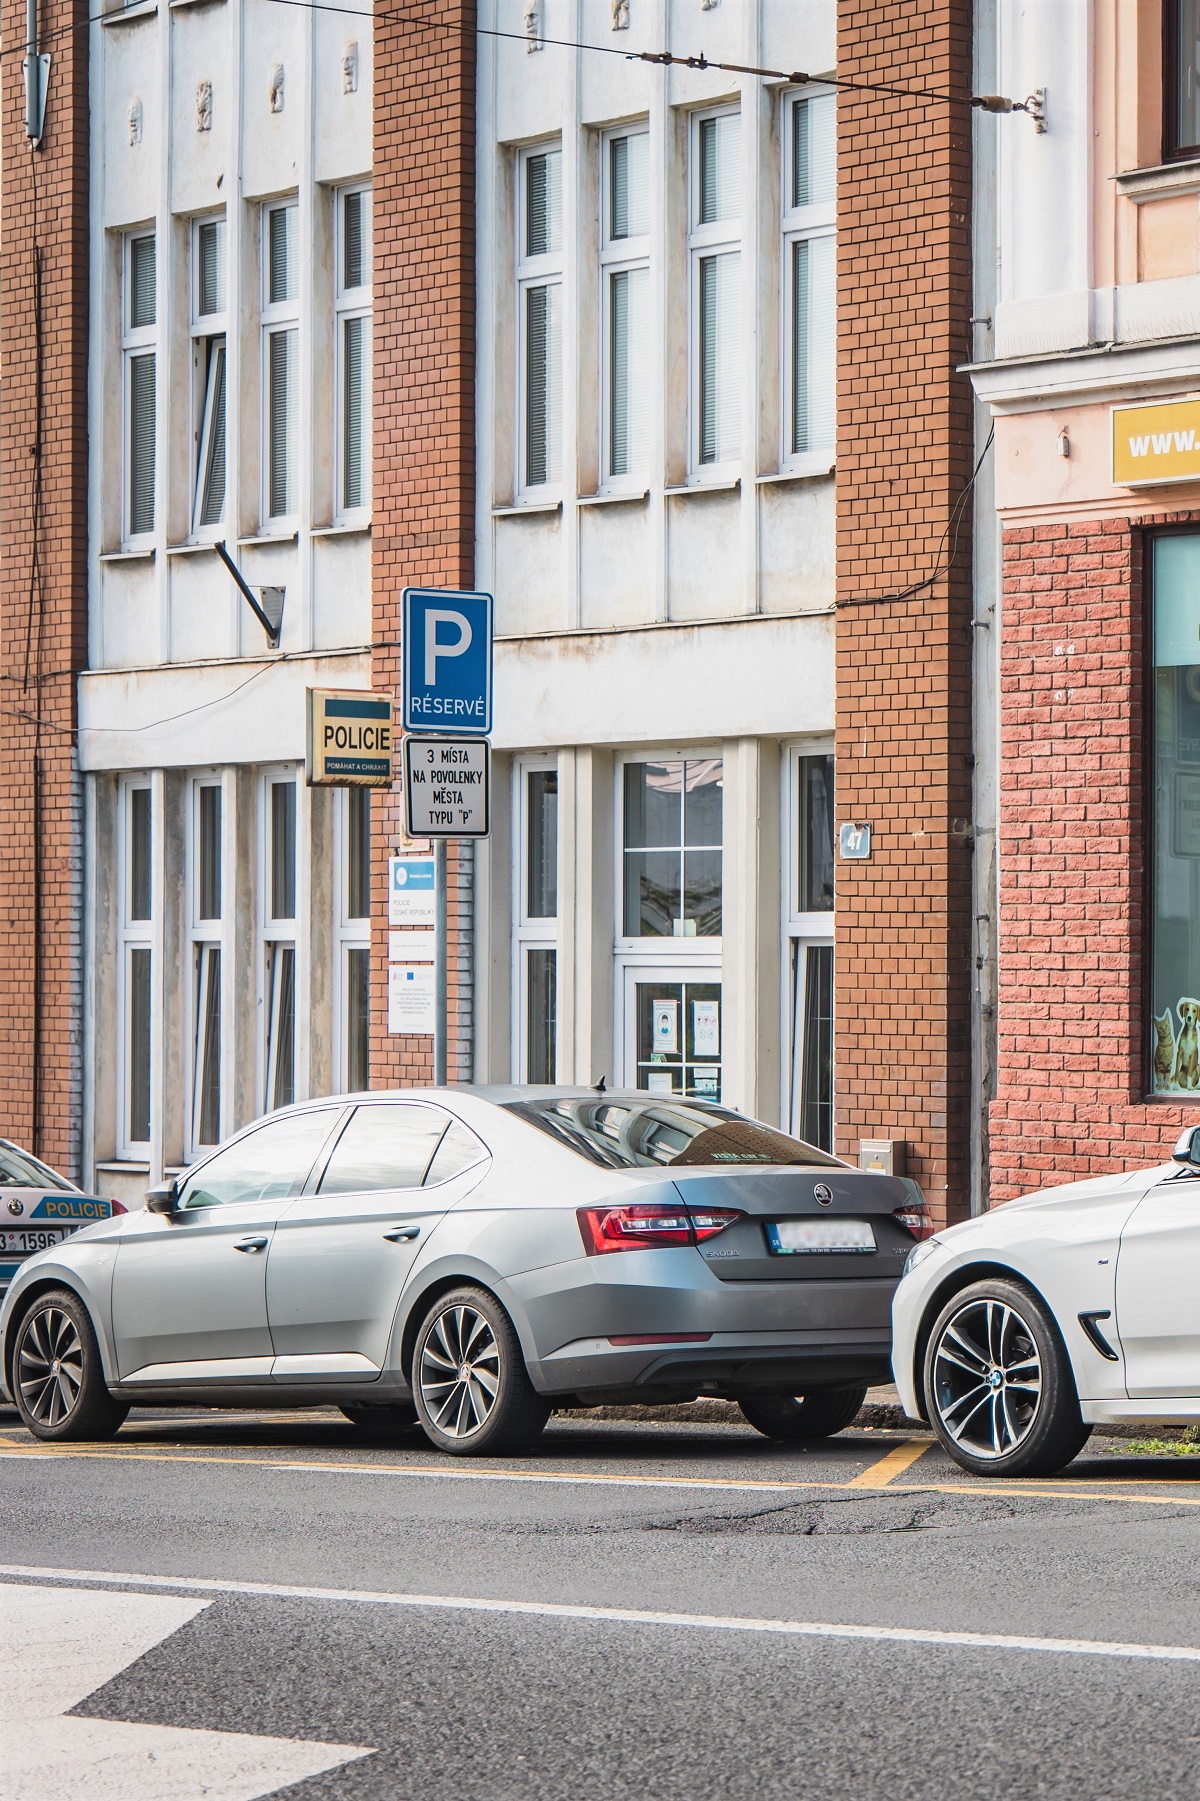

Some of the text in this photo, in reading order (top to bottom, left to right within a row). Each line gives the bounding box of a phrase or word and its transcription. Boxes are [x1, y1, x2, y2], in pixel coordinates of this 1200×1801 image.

[425, 609, 473, 686] P
[411, 693, 485, 717] RÉSERVÉ
[324, 725, 391, 750] POLICIE
[427, 746, 470, 764] 3 MÍSTA
[327, 762, 355, 770] POMÁHAT
[413, 771, 483, 785] NA POVOLENKY
[433, 786, 463, 804] MĚSTA
[429, 809, 473, 824] TYPU "P"
[848, 832, 863, 850] 47
[46, 1202, 108, 1218] POLICIE
[20, 1233, 56, 1250] 1596
